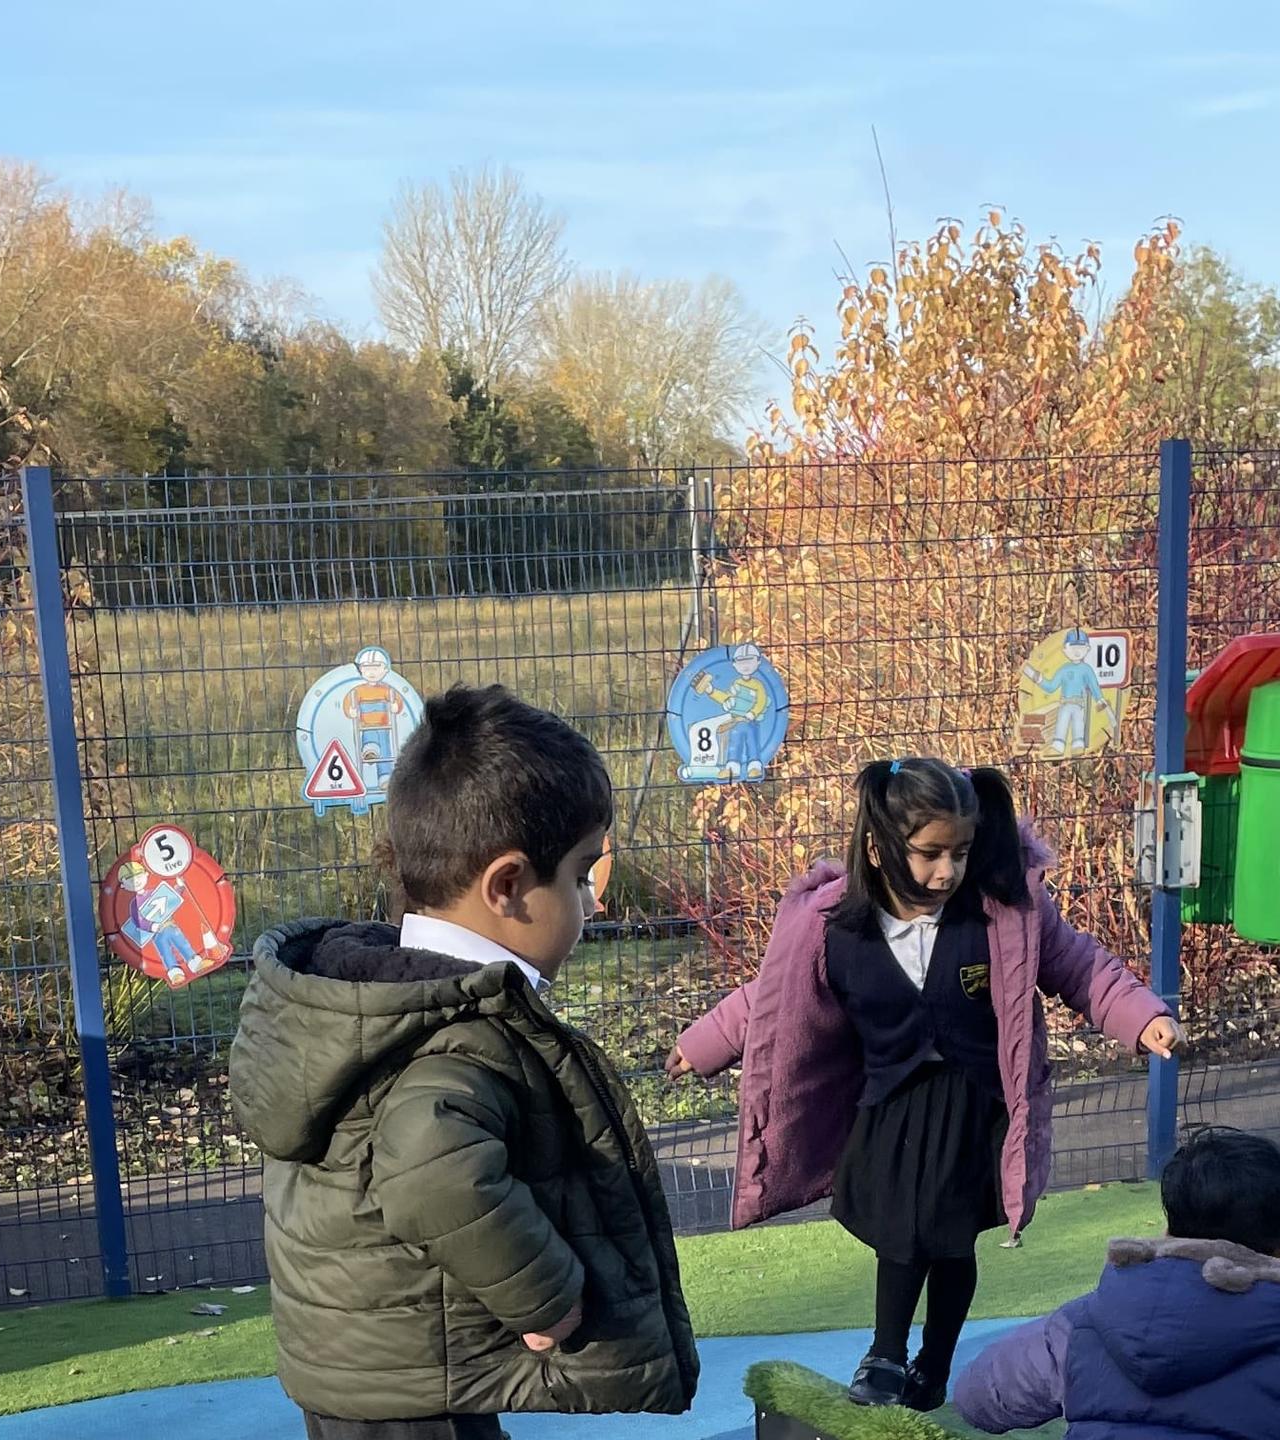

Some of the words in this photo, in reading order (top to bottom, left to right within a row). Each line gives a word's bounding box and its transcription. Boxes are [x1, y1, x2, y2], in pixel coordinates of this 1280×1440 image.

[1096, 643, 1121, 668] 10
[698, 727, 712, 752] 8
[327, 755, 344, 781] 6
[693, 753, 715, 764] eight
[154, 833, 175, 862] 5
[164, 860, 183, 872] five
